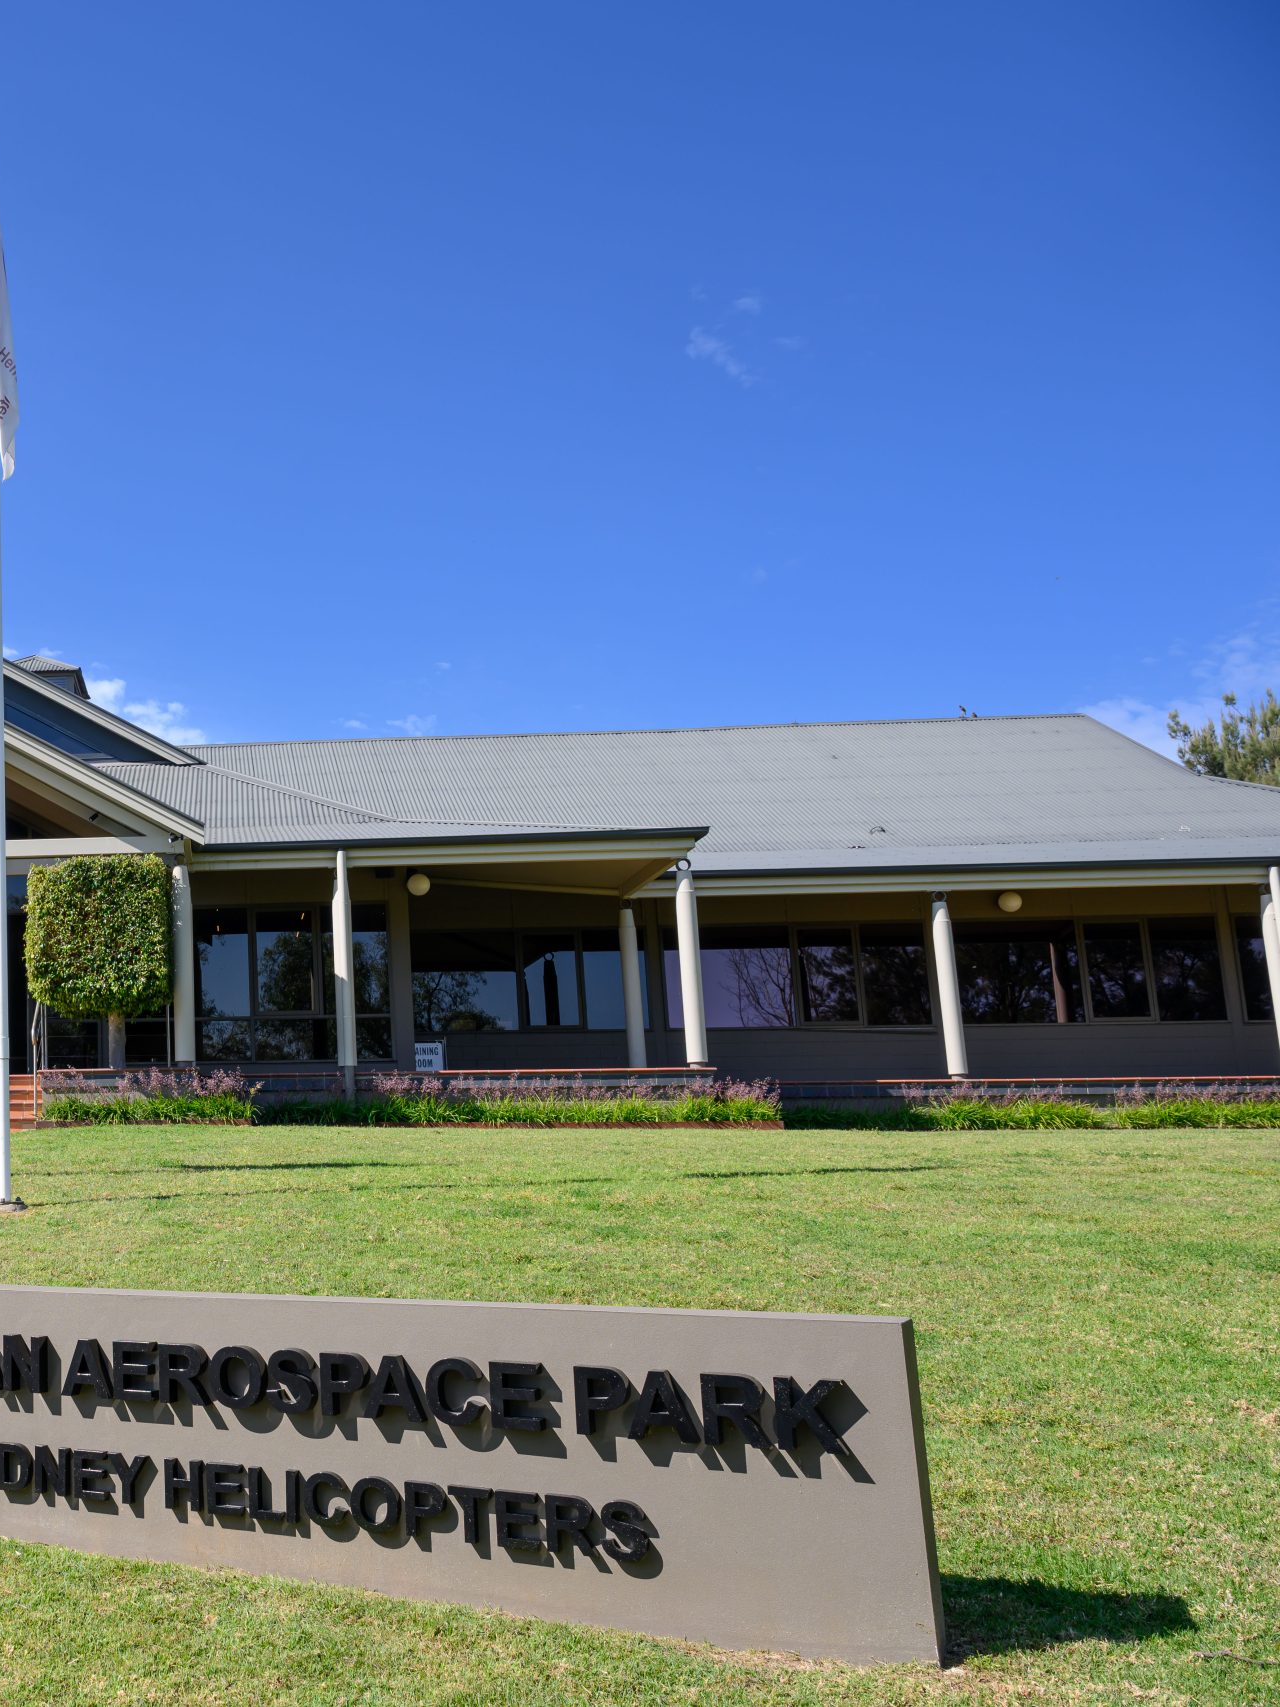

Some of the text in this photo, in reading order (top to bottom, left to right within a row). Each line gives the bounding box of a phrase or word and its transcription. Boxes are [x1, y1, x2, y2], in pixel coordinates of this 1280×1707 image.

[416, 1058, 433, 1068] OOM
[61, 1338, 548, 1433] AEROSPACE
[573, 1365, 851, 1457] PARK
[163, 1456, 650, 1562] HELICOPTERS
